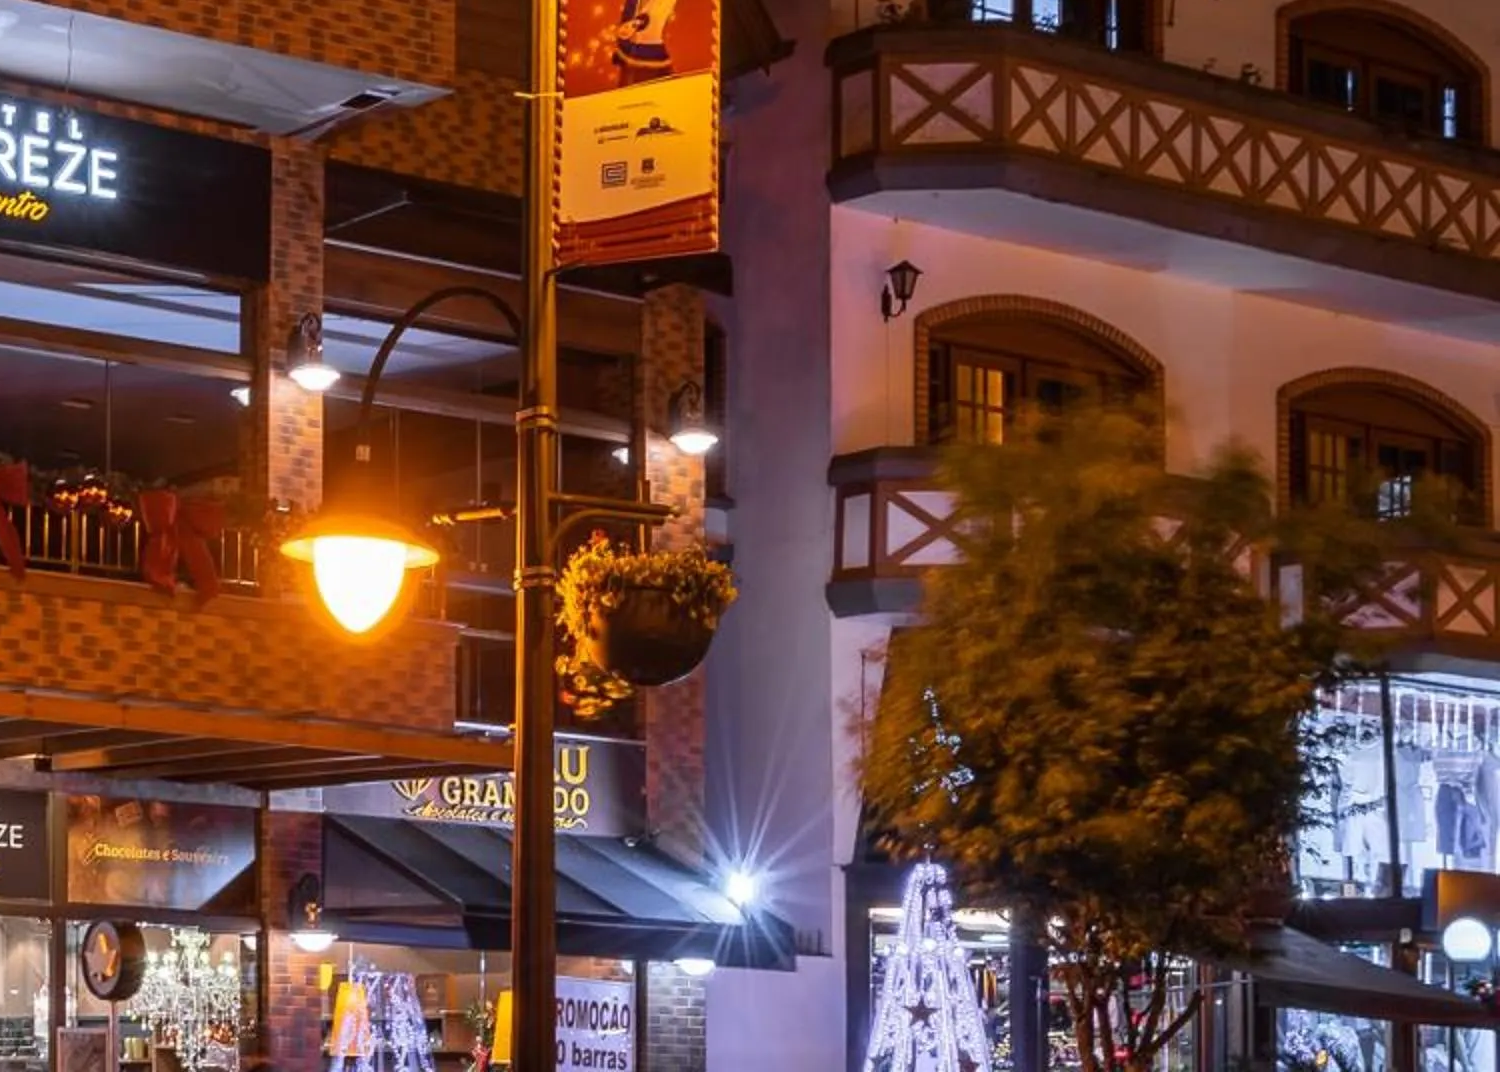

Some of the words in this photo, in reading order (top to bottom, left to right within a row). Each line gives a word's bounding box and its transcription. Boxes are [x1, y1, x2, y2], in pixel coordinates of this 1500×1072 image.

[441, 777, 590, 816] GRADO
[95, 842, 161, 861] Chocolates
[556, 996, 631, 1041] ROMOÇÃO
[572, 1041, 627, 1071] barras
